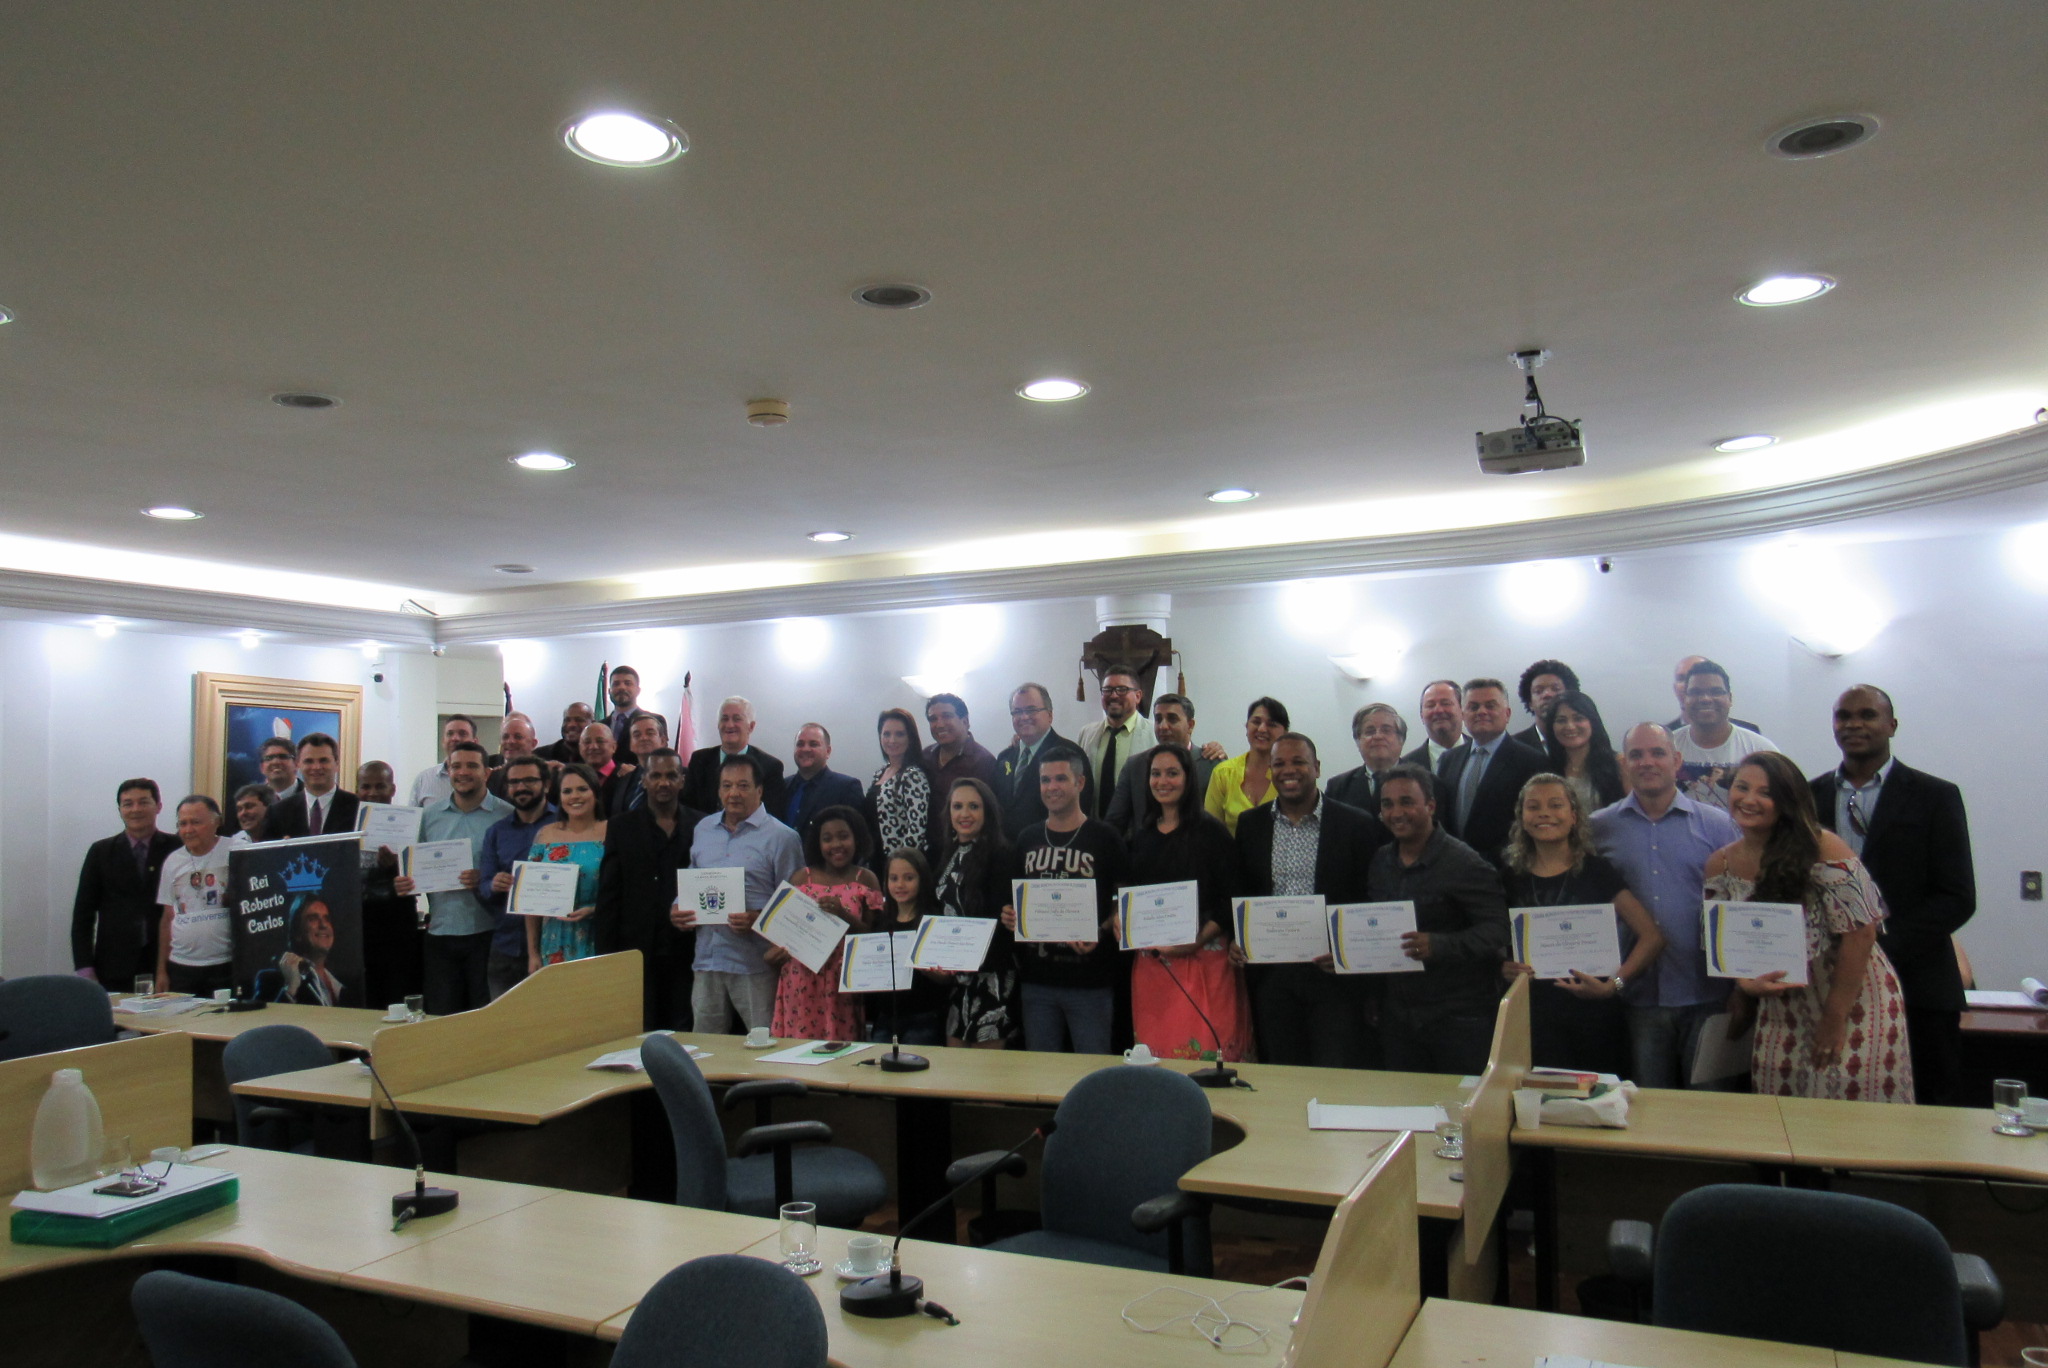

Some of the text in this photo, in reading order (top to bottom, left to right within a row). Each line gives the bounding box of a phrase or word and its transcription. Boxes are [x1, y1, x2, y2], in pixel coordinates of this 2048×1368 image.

[1025, 847, 1094, 877] RUFUS
[249, 875, 269, 891] Rei
[240, 894, 285, 914] Roberto
[248, 916, 284, 934] Carlos
